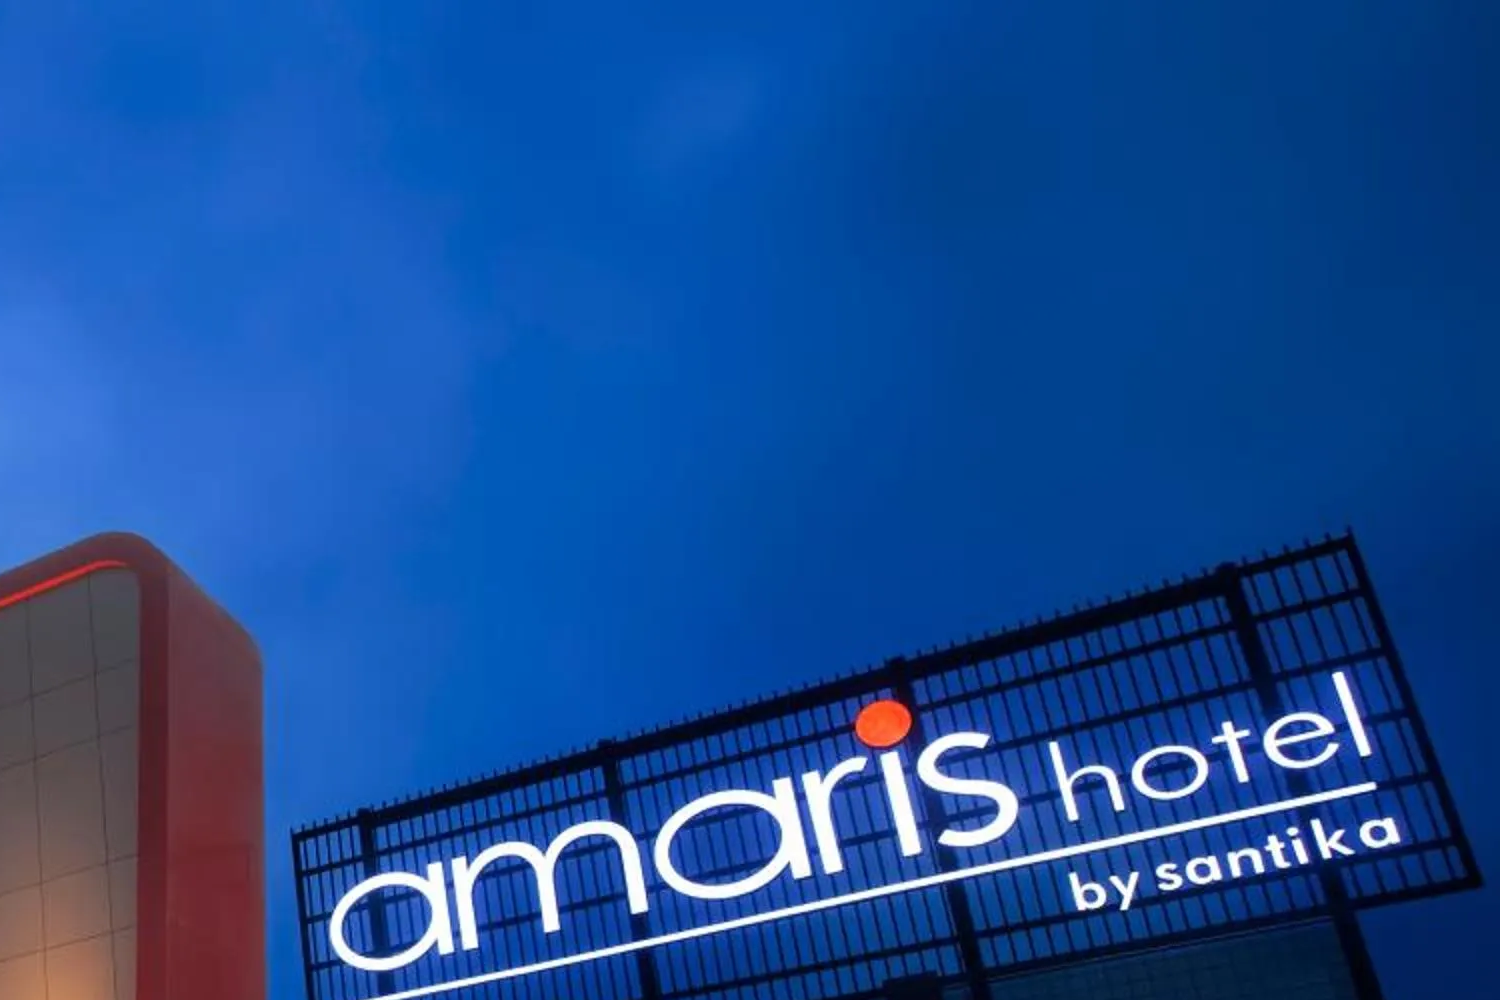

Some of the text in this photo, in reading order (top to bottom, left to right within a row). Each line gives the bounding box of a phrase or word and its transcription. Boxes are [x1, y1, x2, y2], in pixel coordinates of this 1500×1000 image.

[329, 671, 1372, 971] amaris hotel
[1068, 817, 1401, 911] by santika
